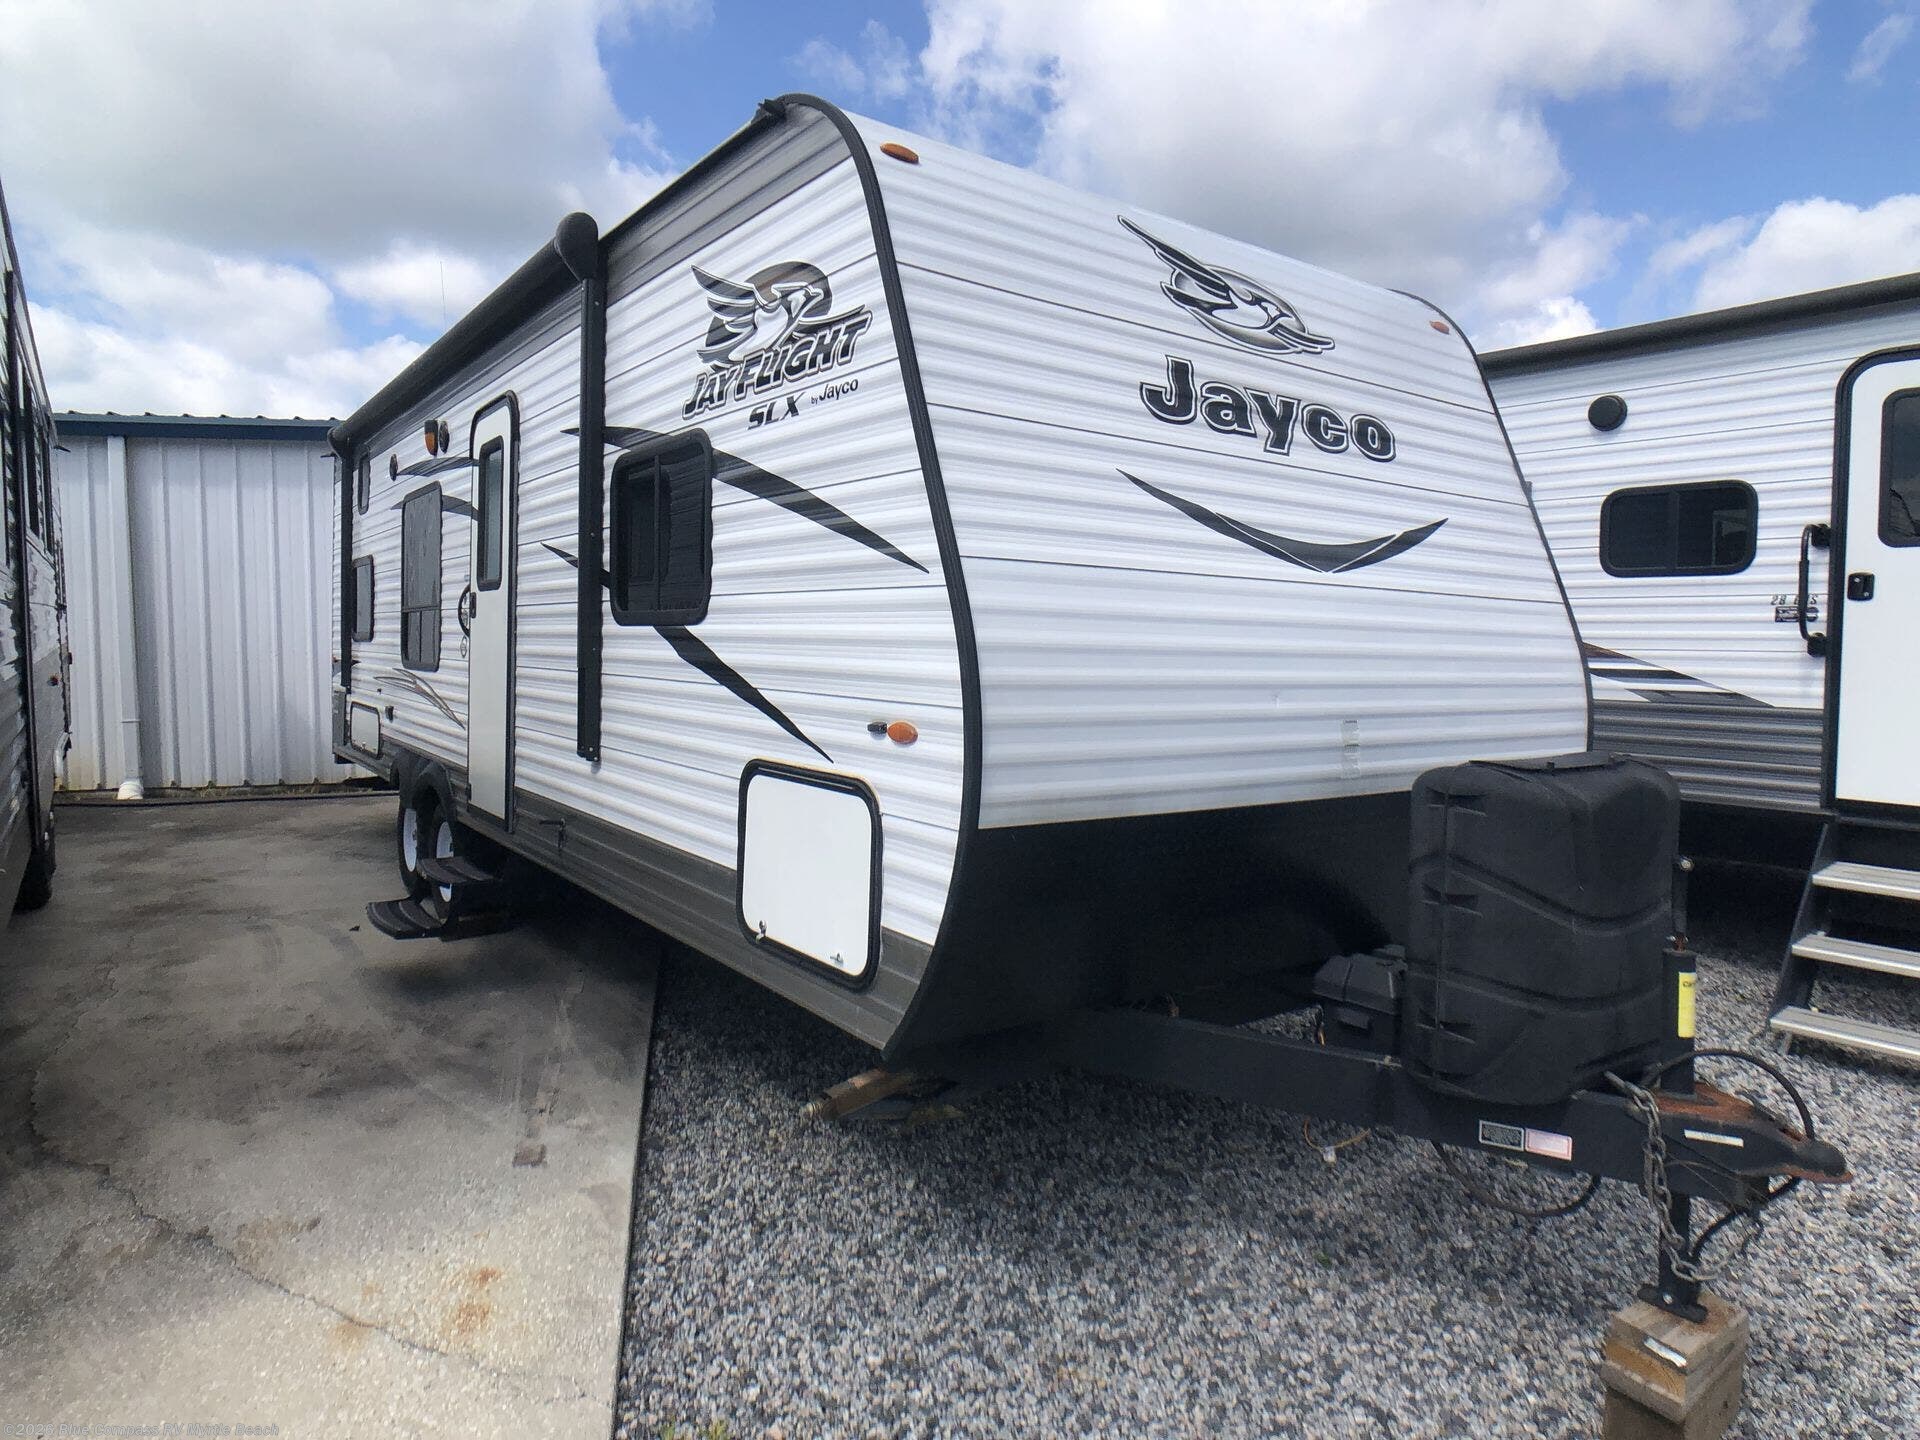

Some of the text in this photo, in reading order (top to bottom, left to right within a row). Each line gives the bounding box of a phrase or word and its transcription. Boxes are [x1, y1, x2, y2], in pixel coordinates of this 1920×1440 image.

[748, 391, 806, 430] SLX
[810, 378, 859, 405] by Jayco
[1140, 354, 1397, 462] Jayco
